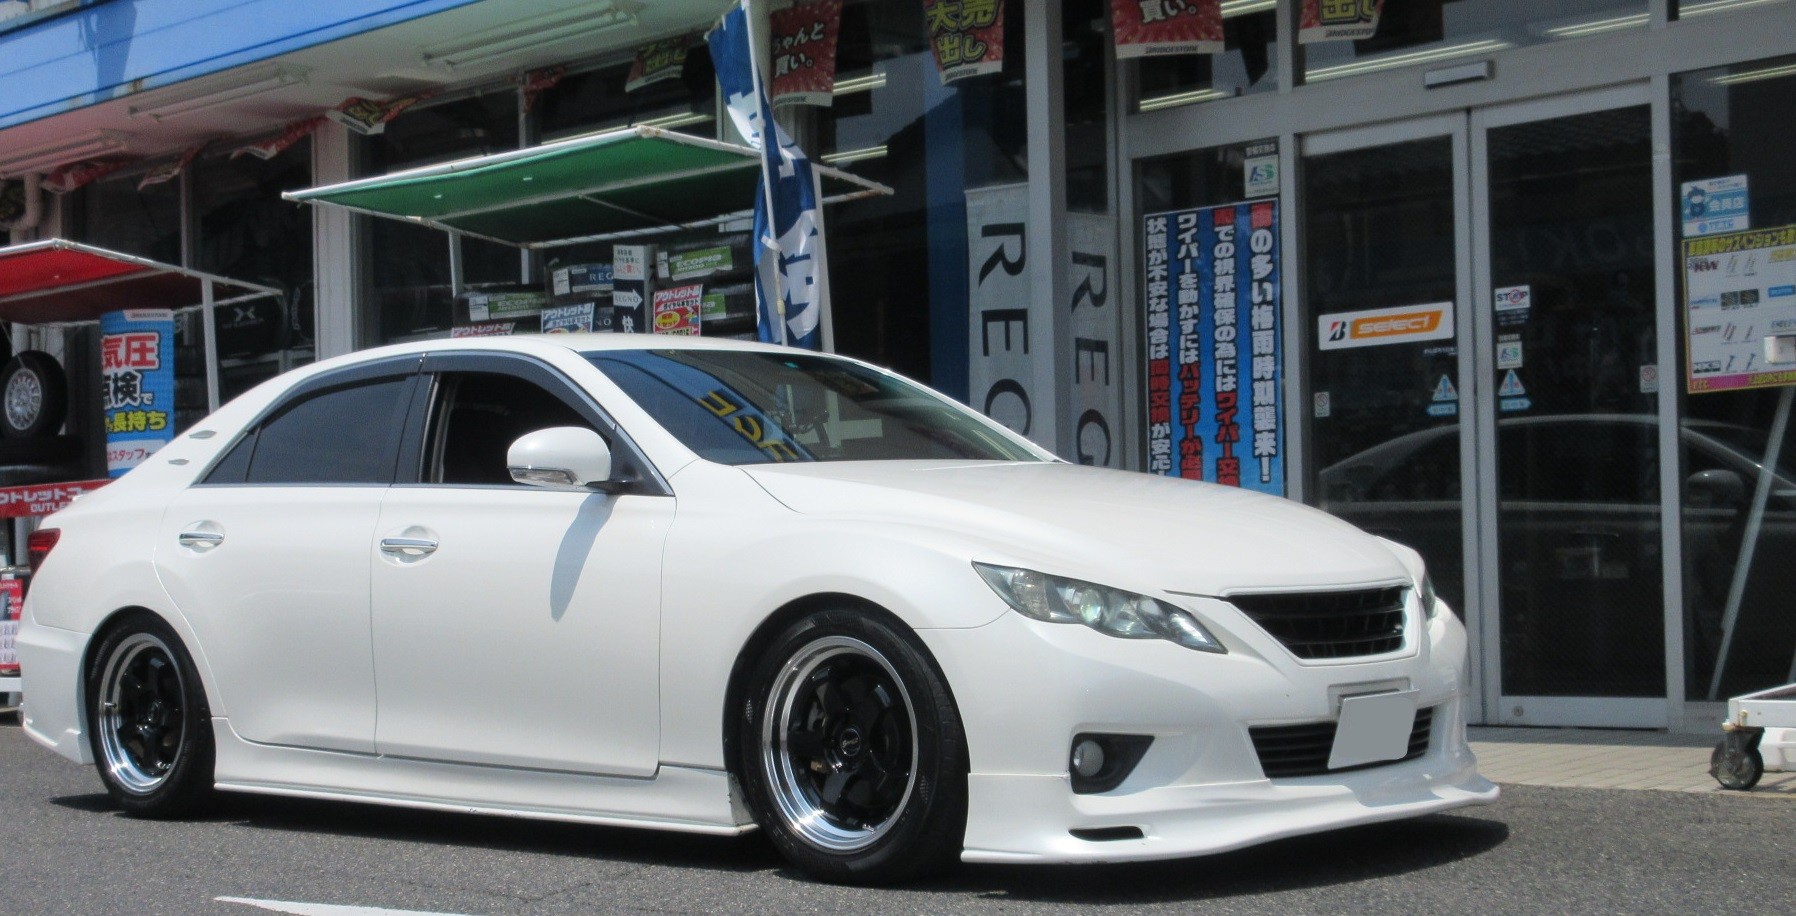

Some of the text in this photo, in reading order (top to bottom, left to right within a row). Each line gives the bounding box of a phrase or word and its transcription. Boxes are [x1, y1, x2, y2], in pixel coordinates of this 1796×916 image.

[938, 34, 987, 65] 出し
[1358, 315, 1431, 334] select
[102, 332, 160, 370] 気圧
